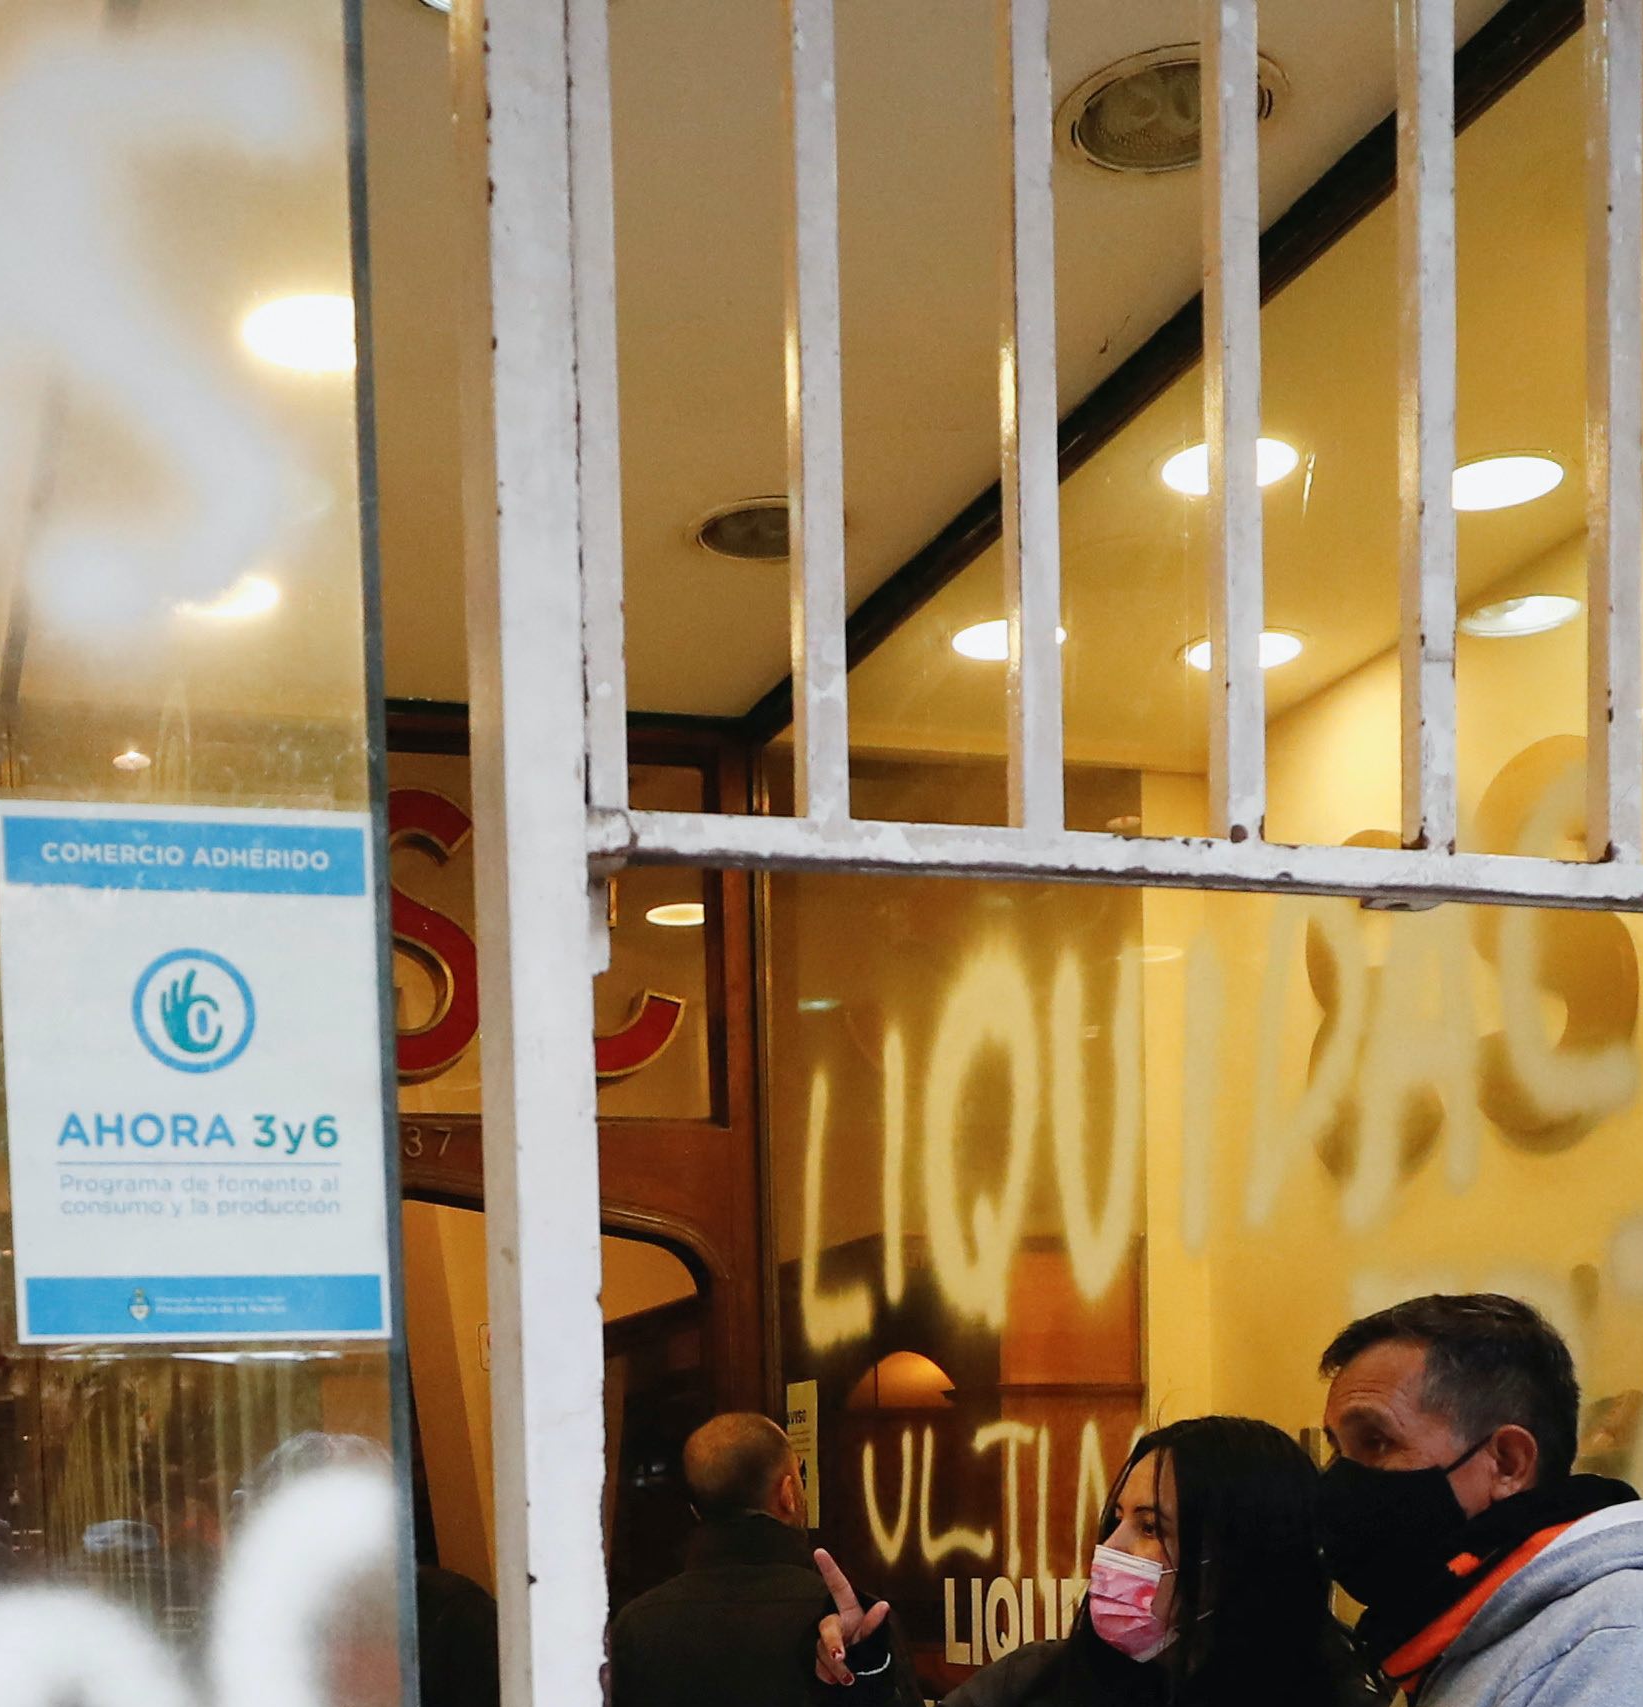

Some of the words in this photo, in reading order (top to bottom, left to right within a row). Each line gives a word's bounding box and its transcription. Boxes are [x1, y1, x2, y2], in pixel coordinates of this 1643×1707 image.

[41, 842, 185, 866] COMERCIO
[192, 847, 331, 872] ADHERIDO
[56, 1113, 235, 1148] AHORA
[59, 1173, 173, 1195] Programa
[181, 1173, 208, 1193] de
[217, 1173, 313, 1193] fomento
[319, 1173, 341, 1193] al
[60, 1199, 165, 1215] consumo
[172, 1201, 182, 1218] y
[190, 1197, 208, 1215] la
[216, 1197, 341, 1217] producción
